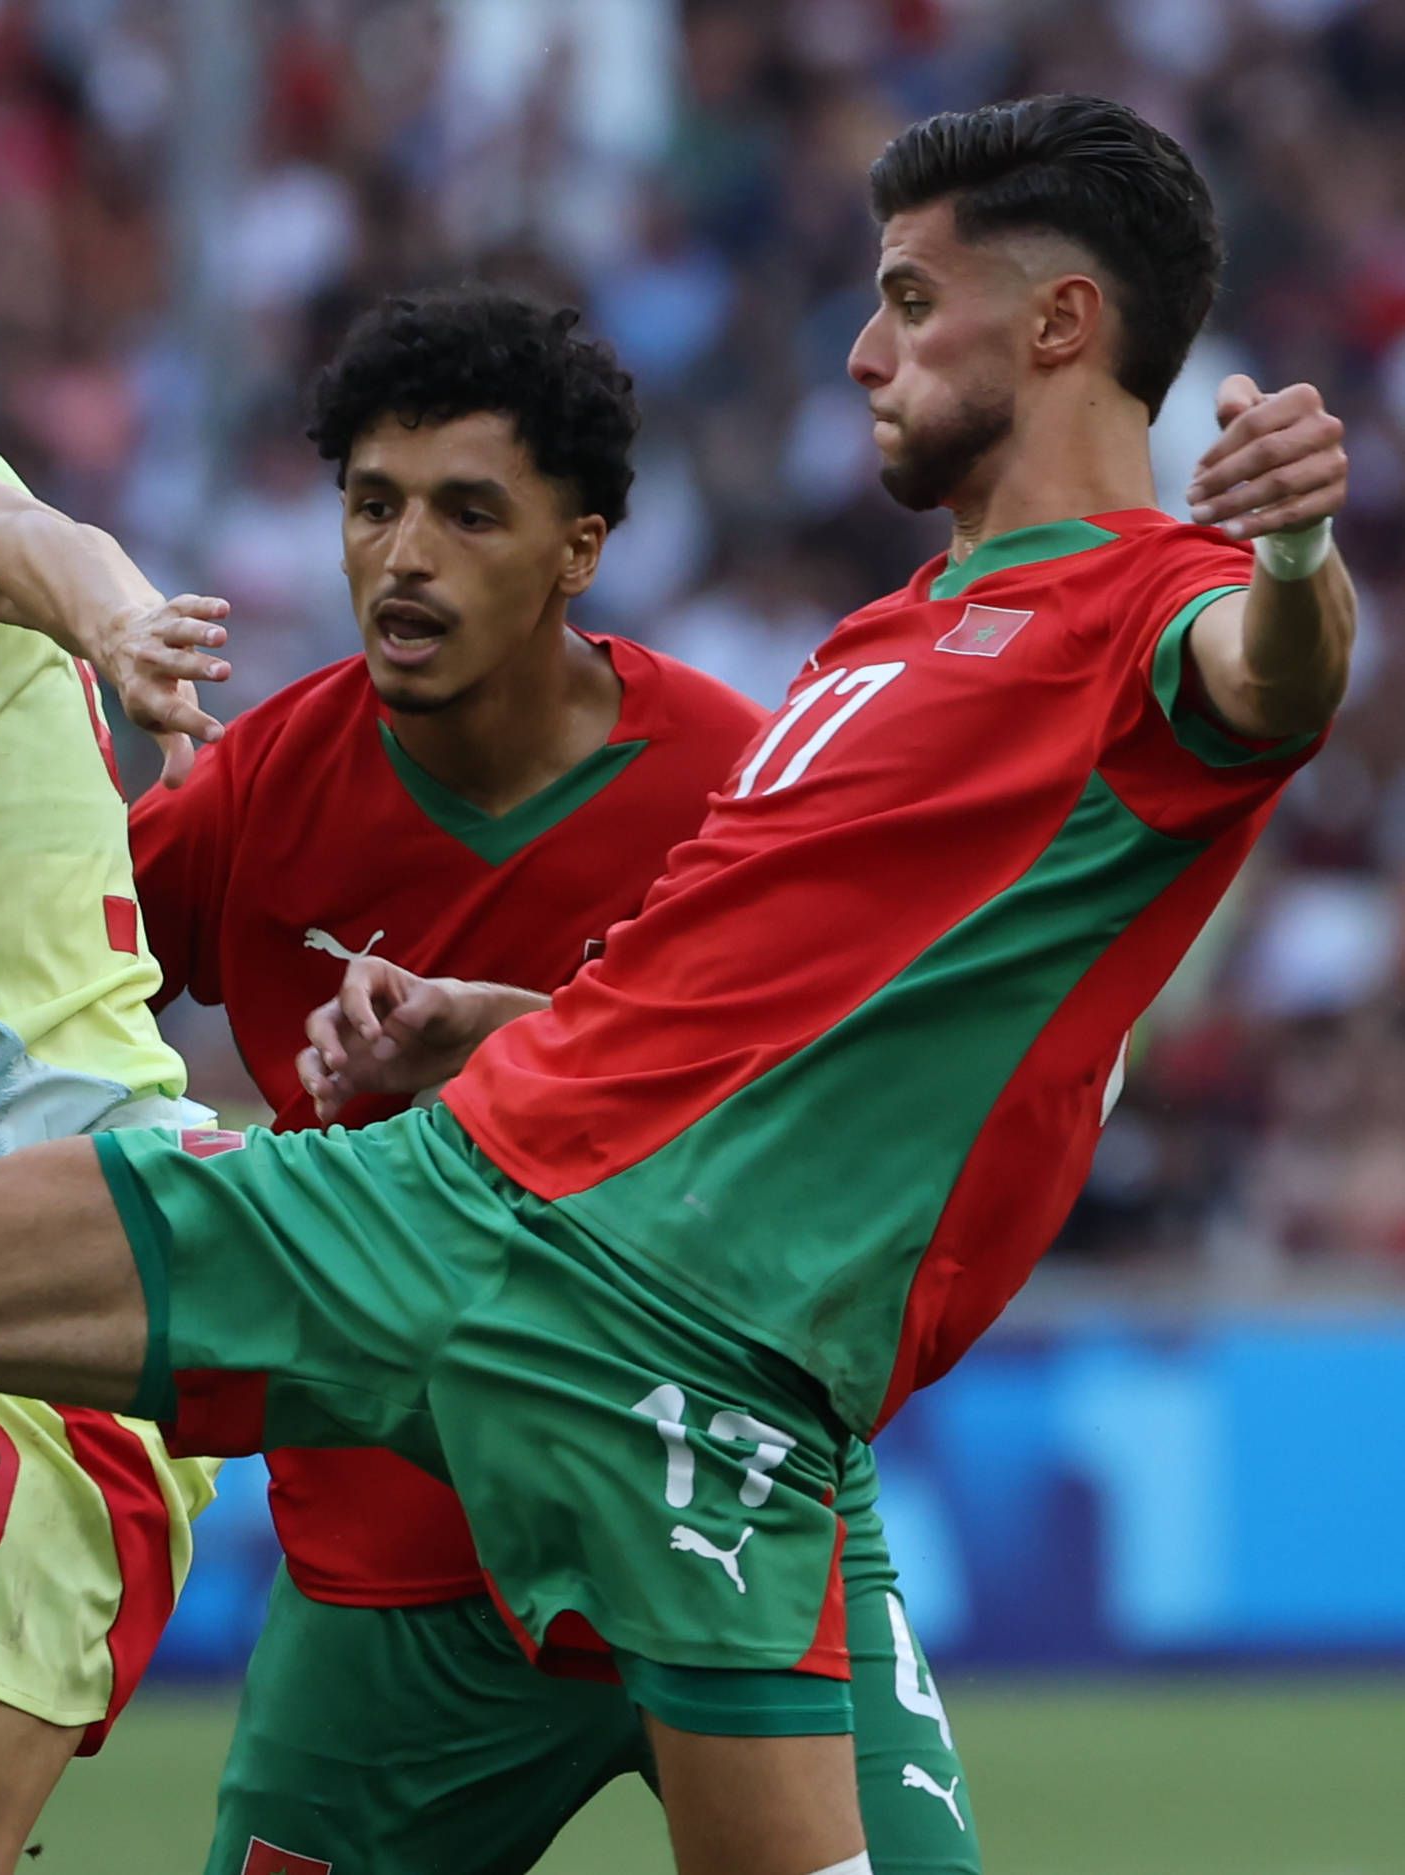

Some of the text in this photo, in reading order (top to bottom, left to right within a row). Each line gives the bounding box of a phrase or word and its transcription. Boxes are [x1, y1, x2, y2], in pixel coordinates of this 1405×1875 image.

[733, 661, 906, 799] 17
[631, 1384, 797, 1508] 17
[886, 1592, 952, 1750] 4
